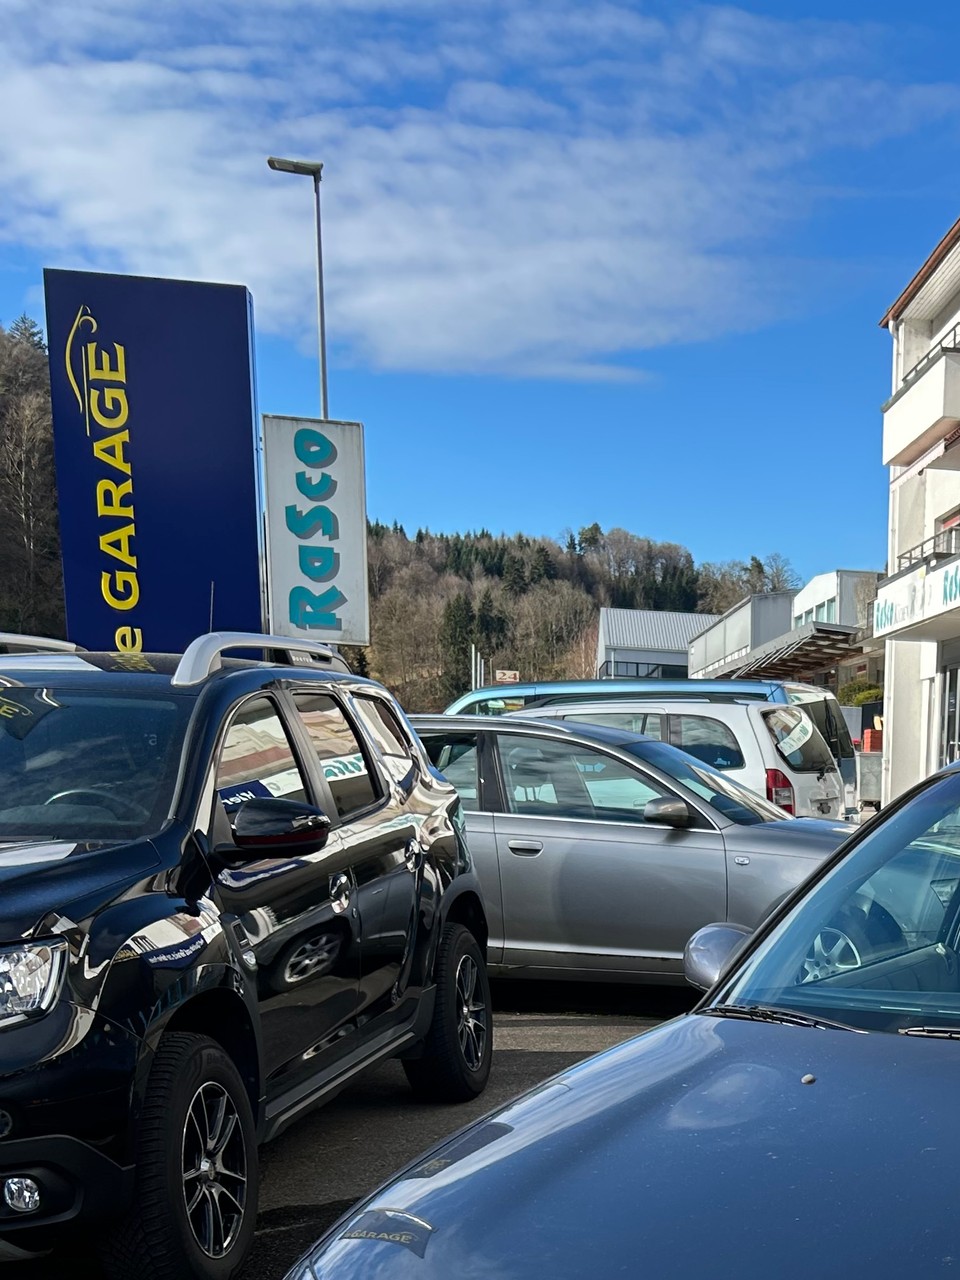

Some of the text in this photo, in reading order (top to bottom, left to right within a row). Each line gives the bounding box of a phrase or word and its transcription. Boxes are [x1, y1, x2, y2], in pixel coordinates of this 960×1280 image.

[87, 341, 142, 653] e GARAGE
[497, 671, 519, 681] 24
